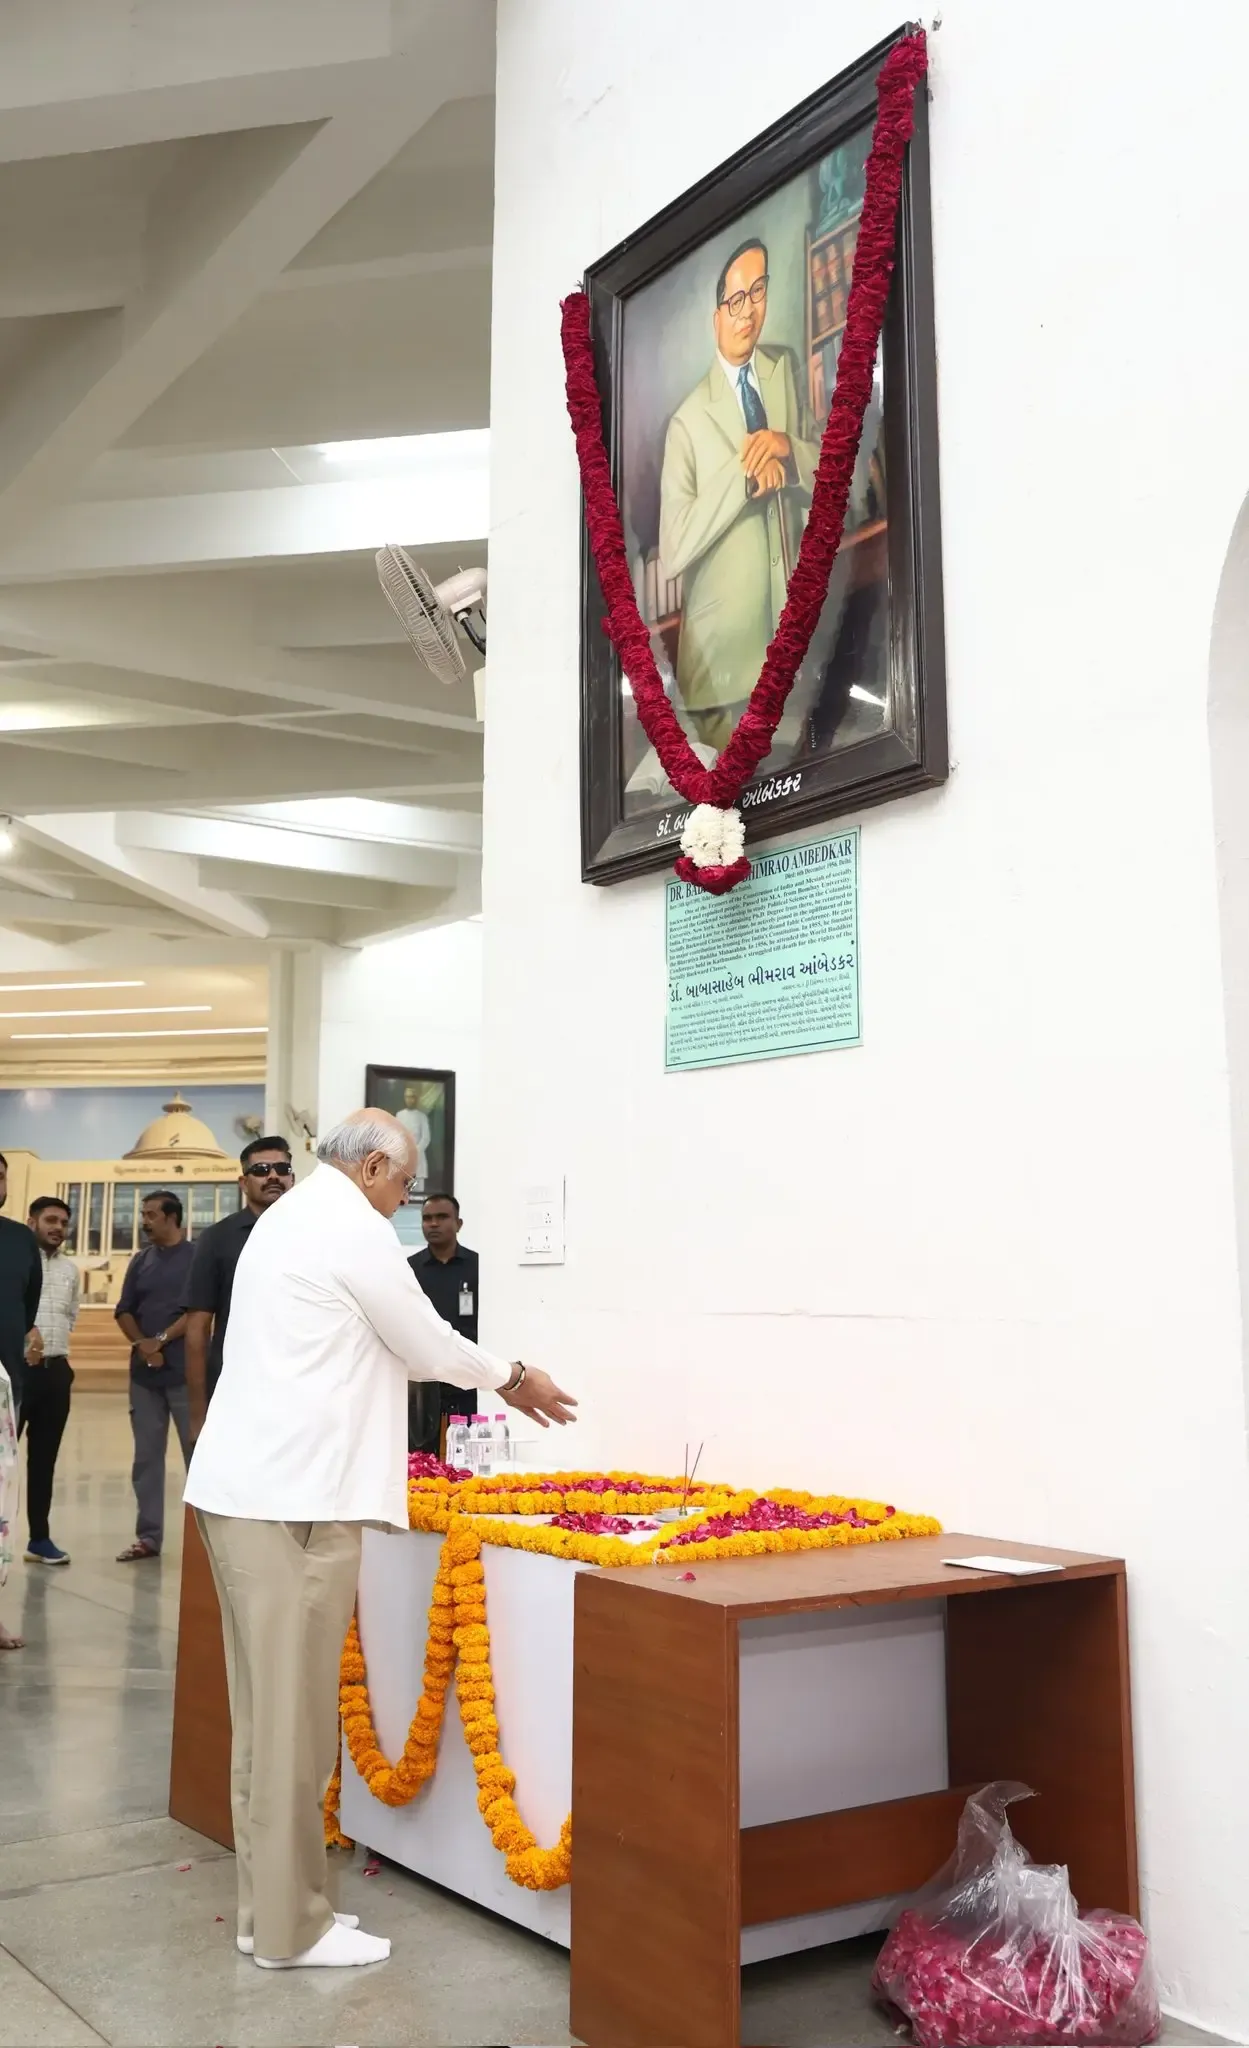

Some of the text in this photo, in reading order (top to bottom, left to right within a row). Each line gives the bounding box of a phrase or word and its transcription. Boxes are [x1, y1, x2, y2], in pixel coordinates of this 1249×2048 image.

[670, 882, 684, 902] DR.
[744, 855, 789, 882] HIMRAO
[792, 838, 852, 869] AMBEDKAR
[685, 971, 744, 999] બાબાસાહેબ
[748, 965, 796, 986] ભીમરાવ
[799, 952, 854, 976] આંબેડકર
